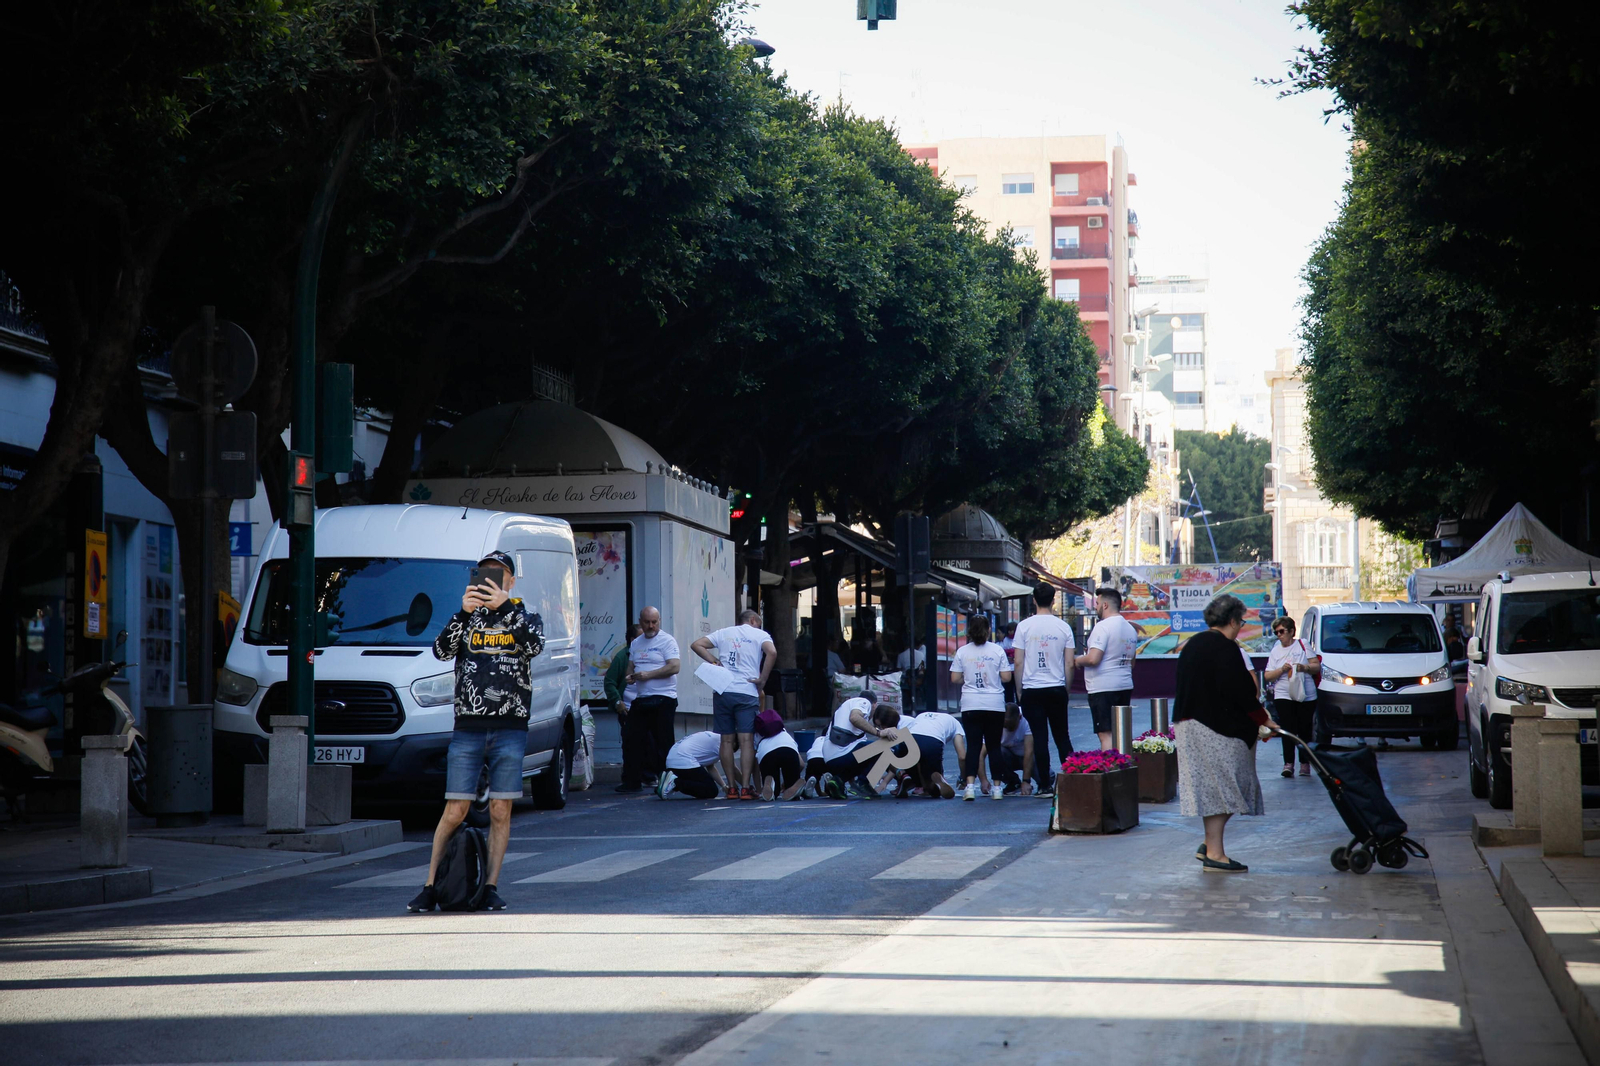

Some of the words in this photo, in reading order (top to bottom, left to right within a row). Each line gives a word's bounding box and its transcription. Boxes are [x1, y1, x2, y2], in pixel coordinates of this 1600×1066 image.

[459, 488, 479, 504] El
[483, 486, 537, 505] Kiosko
[543, 487, 559, 502] de
[565, 486, 585, 502] las
[590, 485, 637, 501] Flores
[576, 541, 597, 555] sate
[578, 557, 593, 566] res
[930, 560, 970, 569] OUVENIR
[1180, 588, 1210, 597] TÍJOLA
[472, 633, 483, 646] EL
[1372, 705, 1392, 713] 8320
[1394, 705, 1410, 713] KDZ
[314, 749, 333, 761] 26
[337, 749, 361, 761] HYJ
